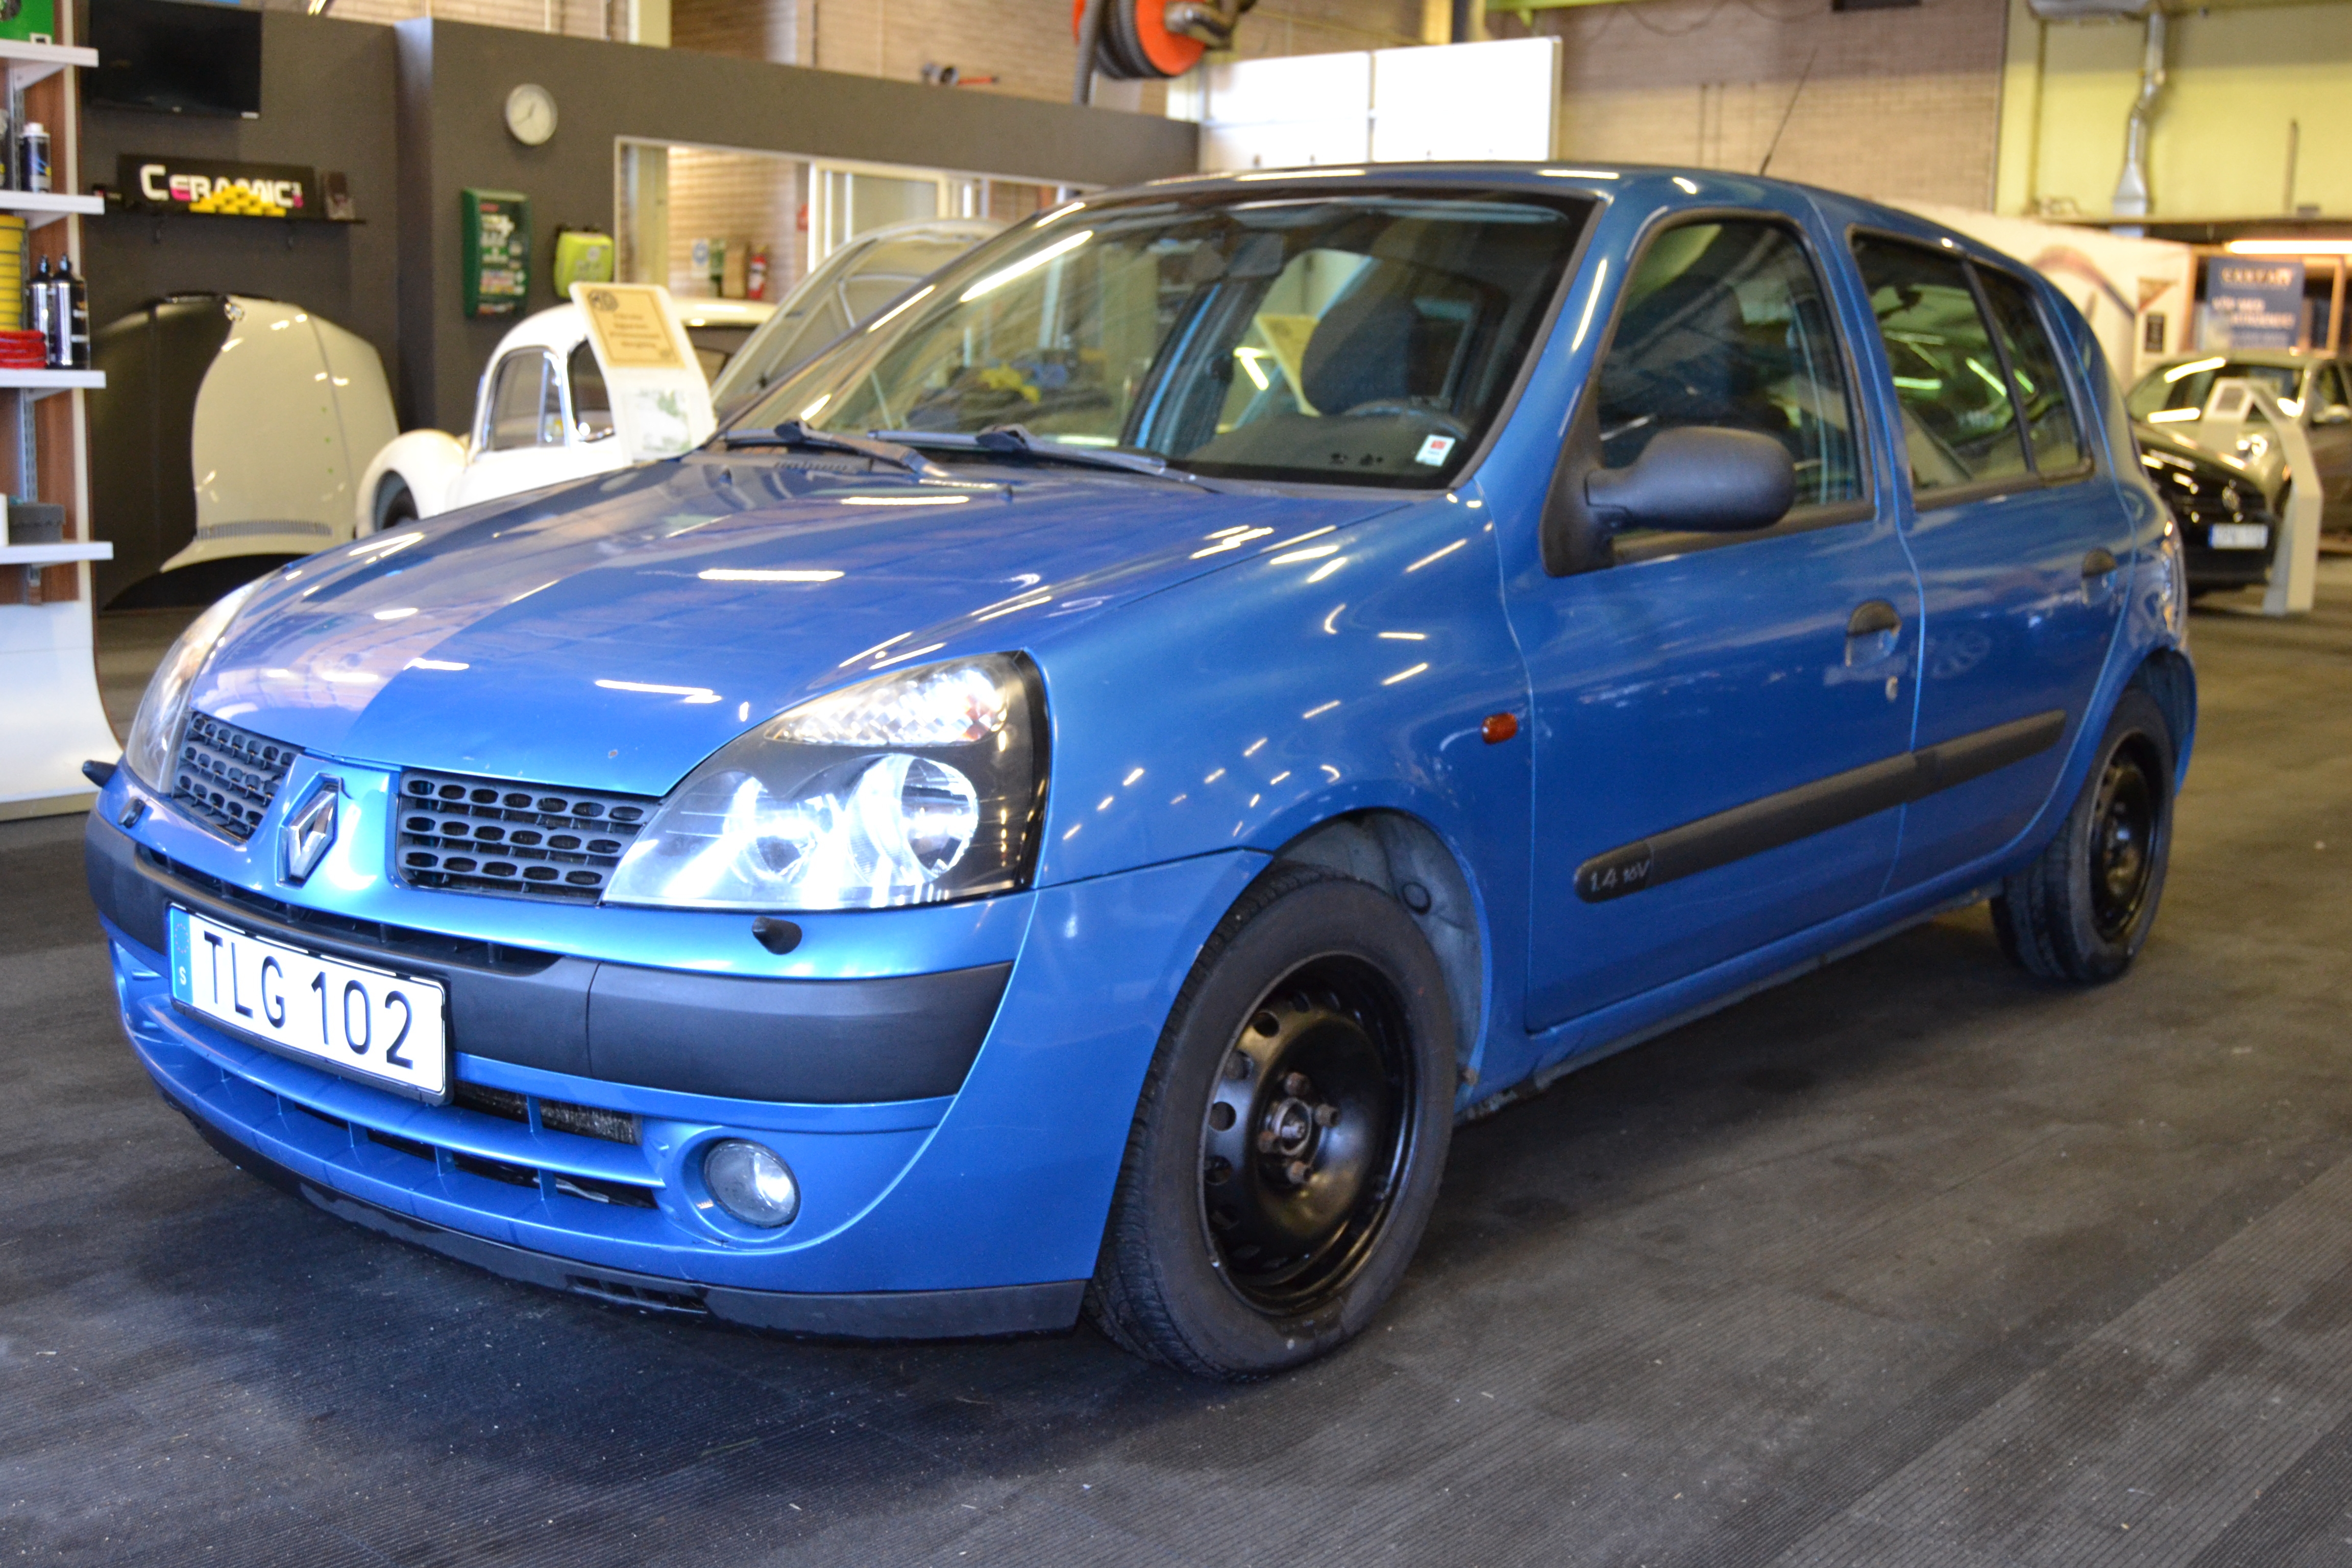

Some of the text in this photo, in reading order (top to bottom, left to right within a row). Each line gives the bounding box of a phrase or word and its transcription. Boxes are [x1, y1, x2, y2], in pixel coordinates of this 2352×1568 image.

[180, 966, 187, 986] S
[204, 929, 414, 1070] TLG 102
